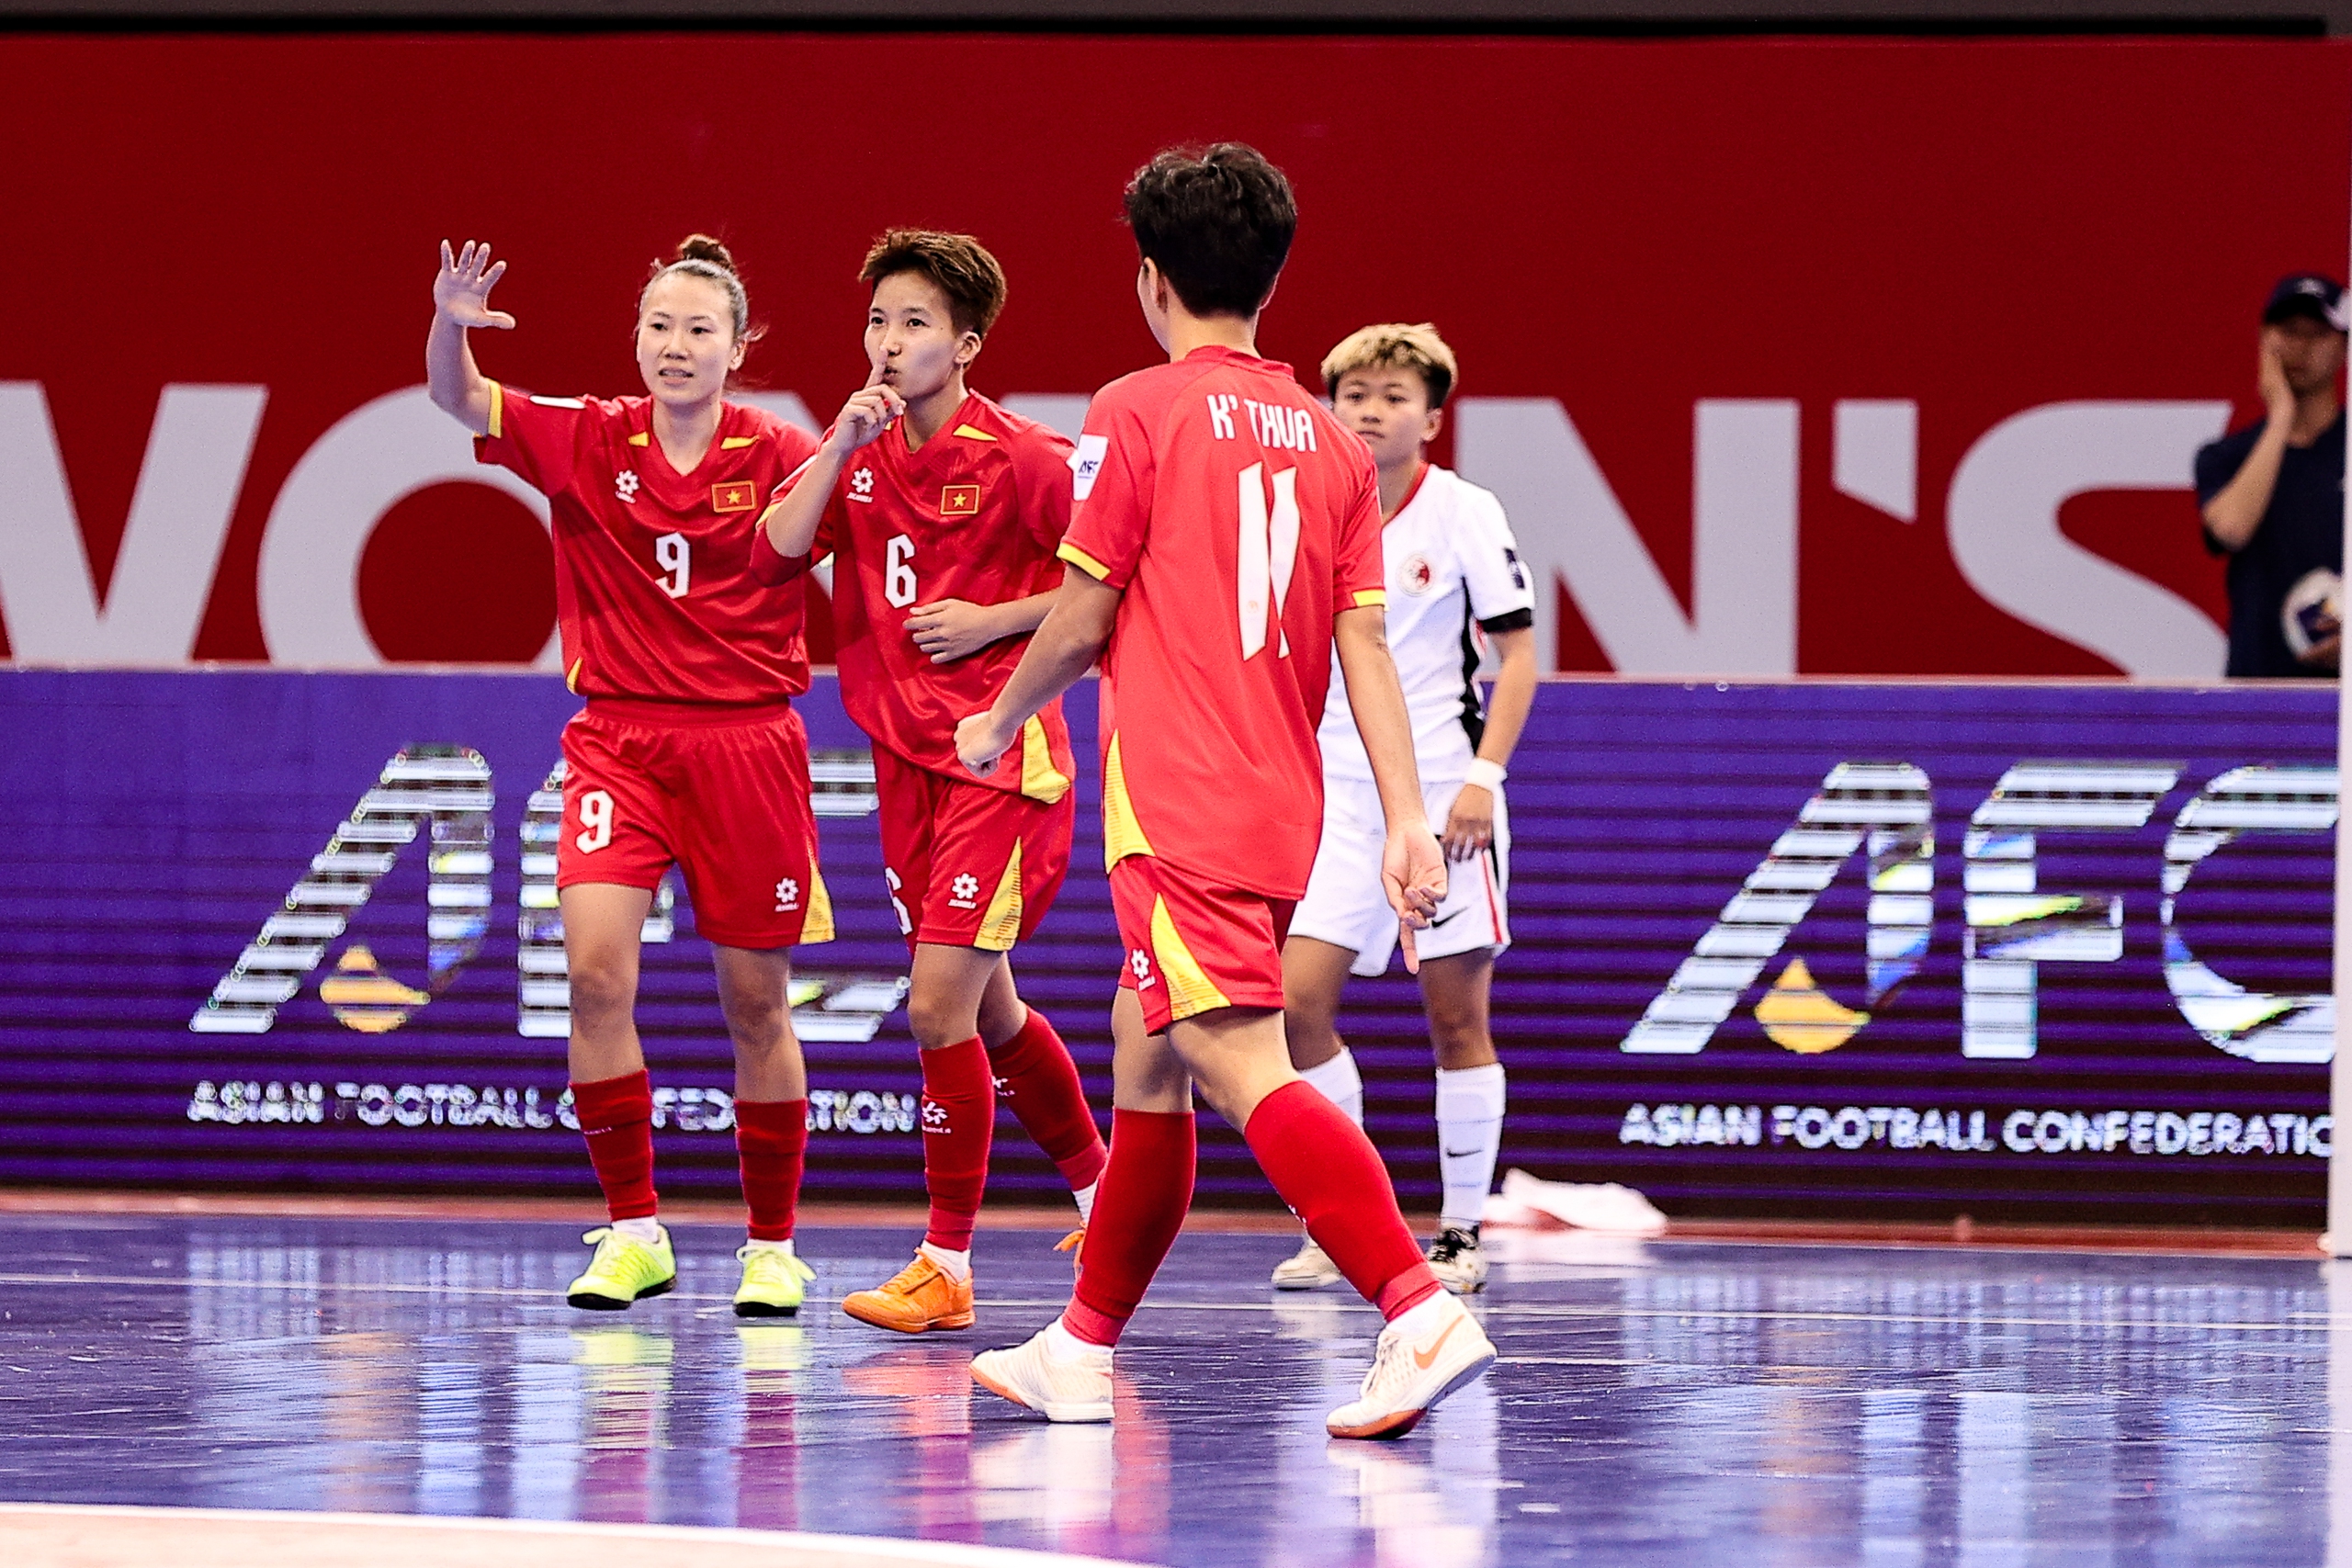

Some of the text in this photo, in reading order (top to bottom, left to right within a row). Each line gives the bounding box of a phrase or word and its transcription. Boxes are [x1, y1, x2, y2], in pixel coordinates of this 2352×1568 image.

[1206, 393, 1317, 453] K' THUA
[654, 532, 690, 599] 9
[885, 534, 917, 609] 6
[1237, 460, 1302, 661] 11
[575, 790, 615, 855] 9
[1620, 761, 2339, 1063] AFC
[187, 1079, 324, 1123] ASIAN
[334, 1083, 553, 1129] FOOTBALL
[1619, 1102, 1762, 1146] ASIAN
[1770, 1105, 1996, 1151] FOOTBALL
